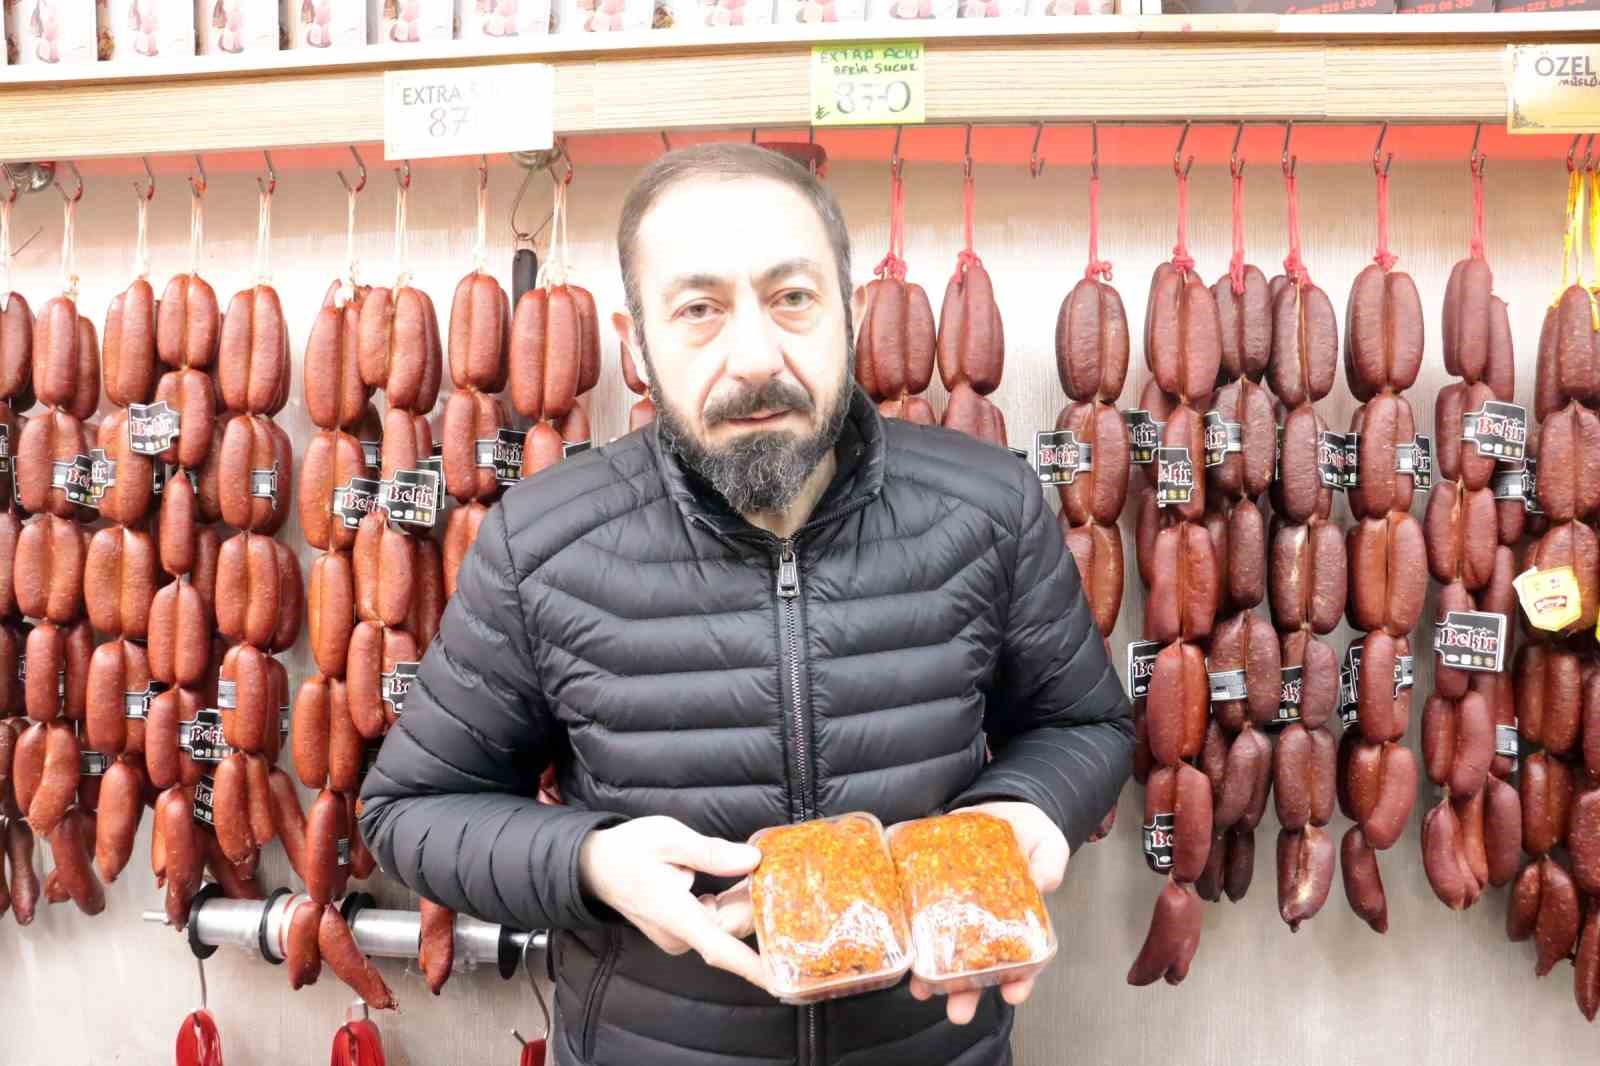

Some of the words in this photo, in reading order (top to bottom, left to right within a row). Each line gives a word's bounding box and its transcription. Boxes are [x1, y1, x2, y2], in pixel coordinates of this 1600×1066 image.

[820, 47, 874, 63] EXTRA
[1534, 50, 1597, 77] ÖZEL
[402, 84, 464, 106] EXTRA
[1477, 416, 1526, 444] Bekir
[388, 484, 434, 509] Bekir
[1440, 627, 1498, 653] Bekir
